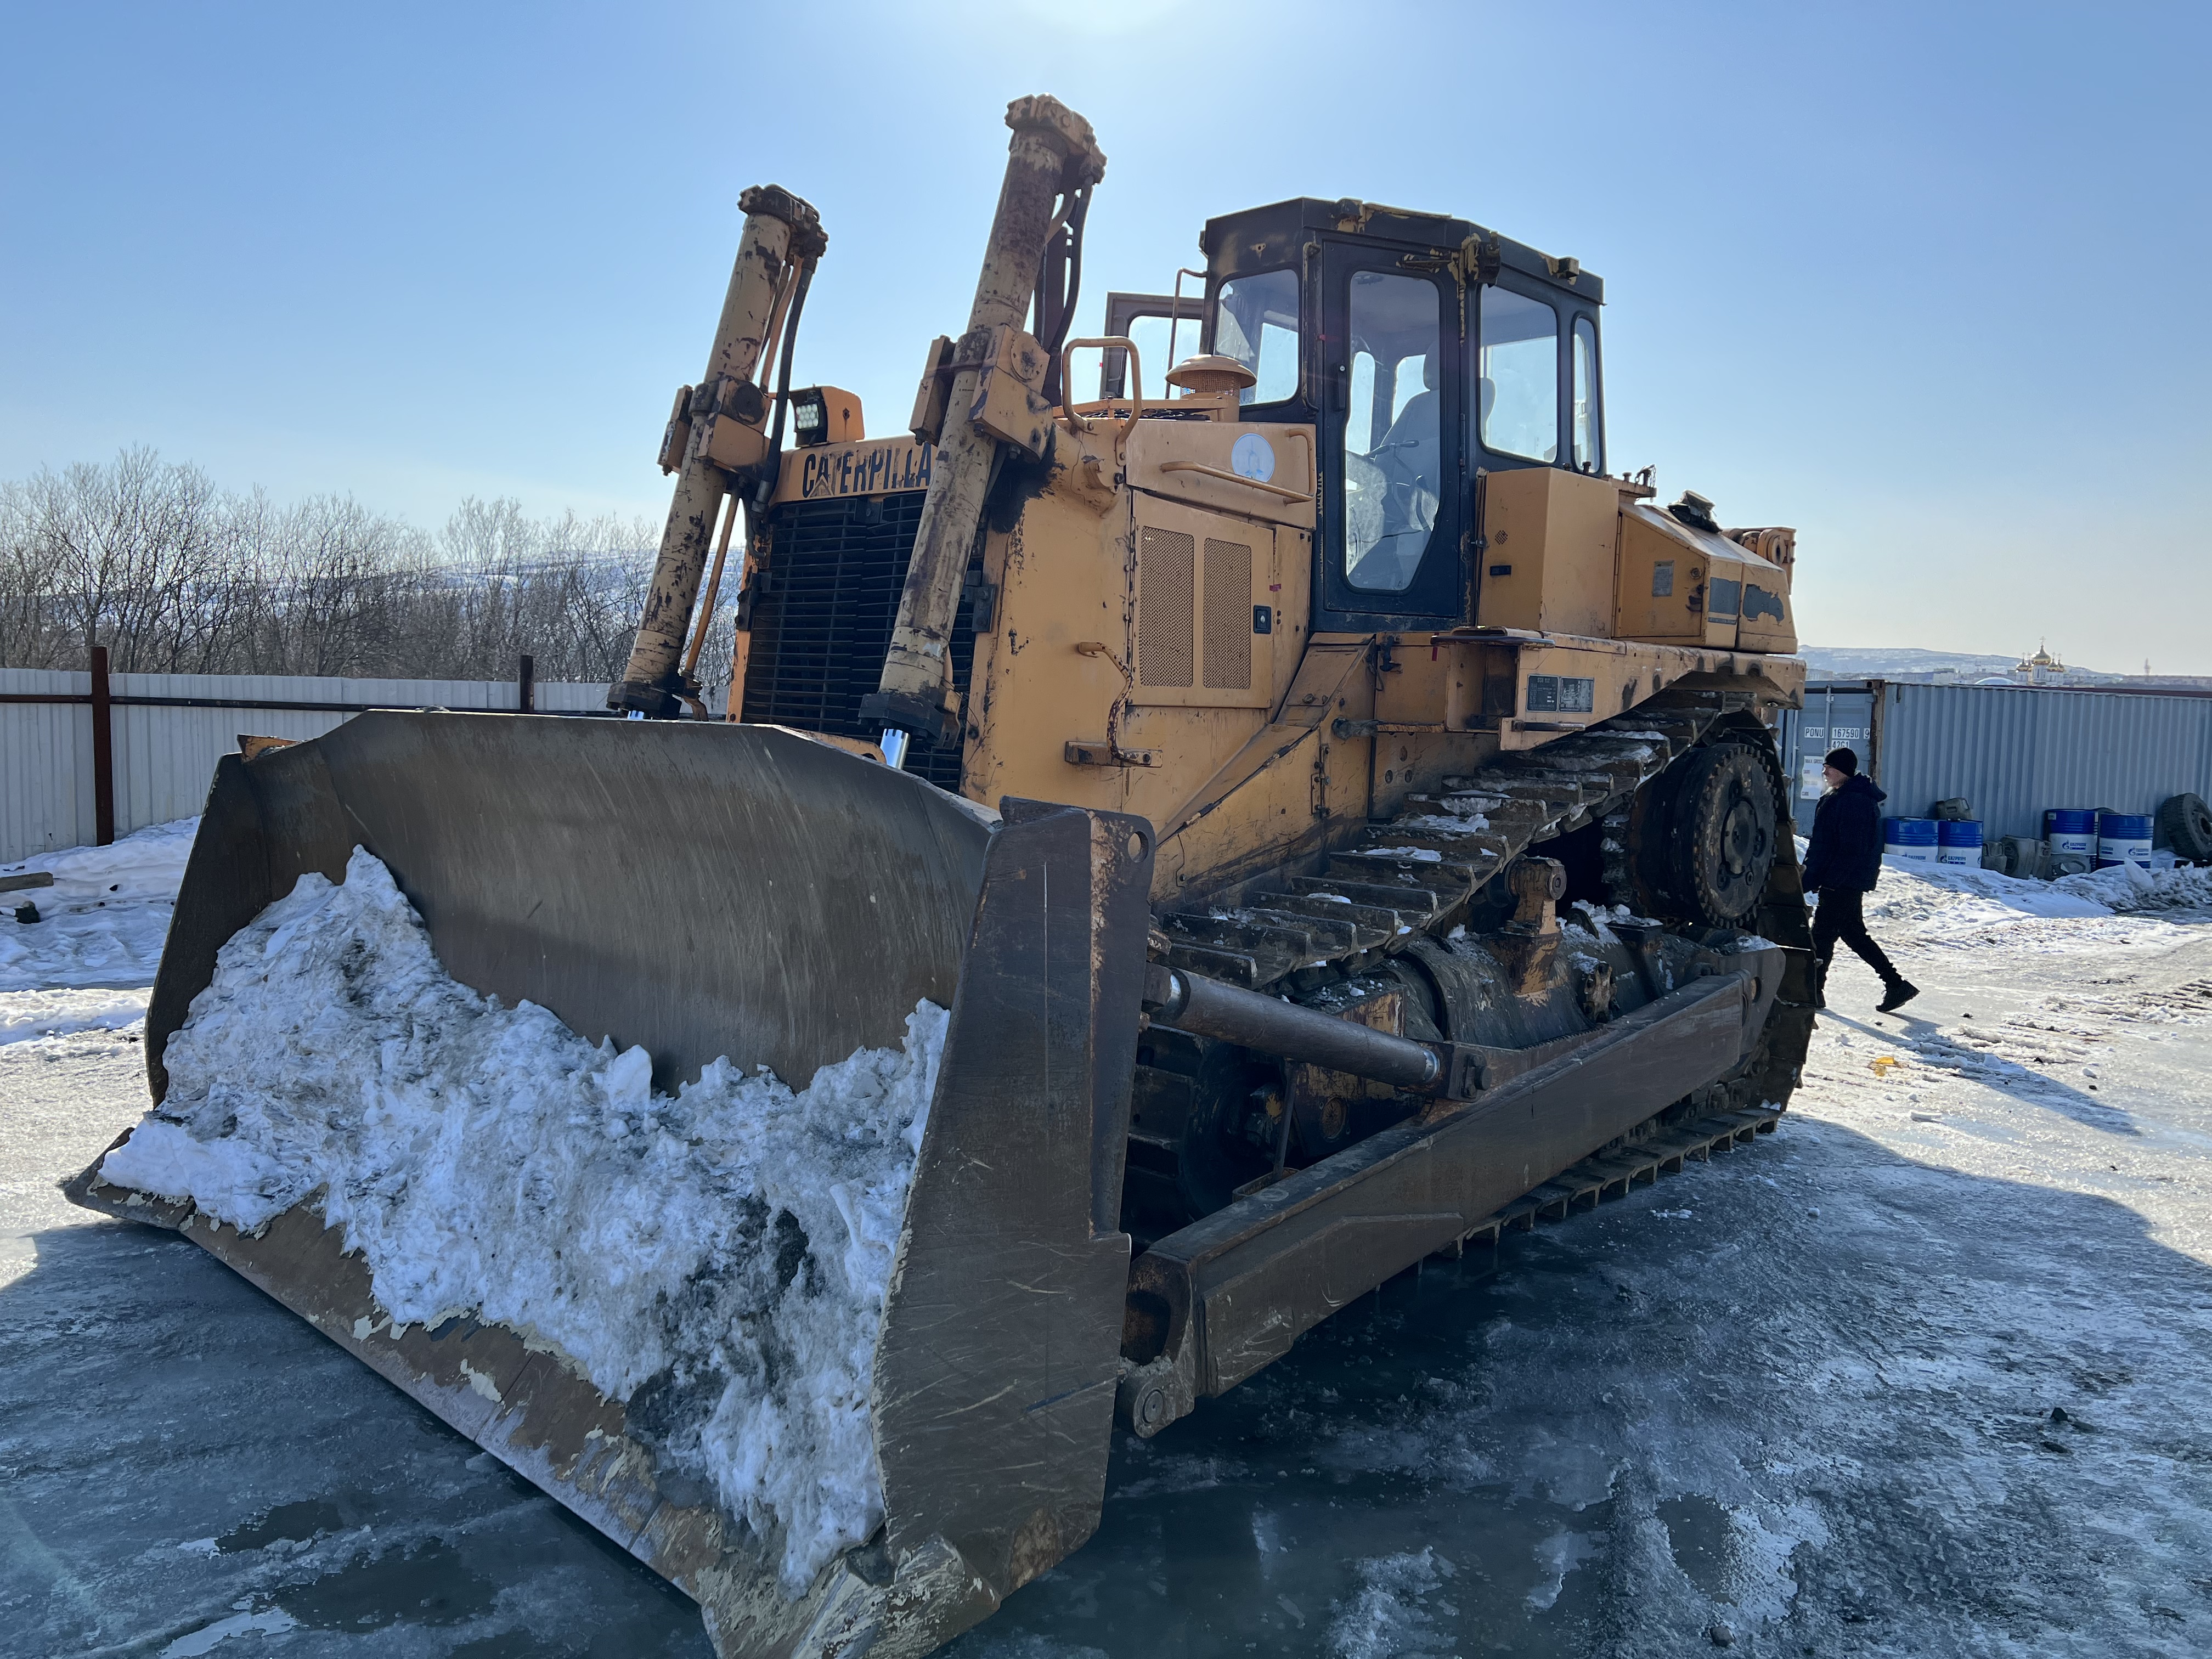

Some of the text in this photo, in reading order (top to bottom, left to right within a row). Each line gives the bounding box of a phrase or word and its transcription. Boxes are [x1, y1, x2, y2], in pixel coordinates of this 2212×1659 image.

[803, 442, 932, 498] CATERPILLA
[1805, 728, 1870, 738] PONU 167590 9
[1832, 741, 1849, 749] 42G1
